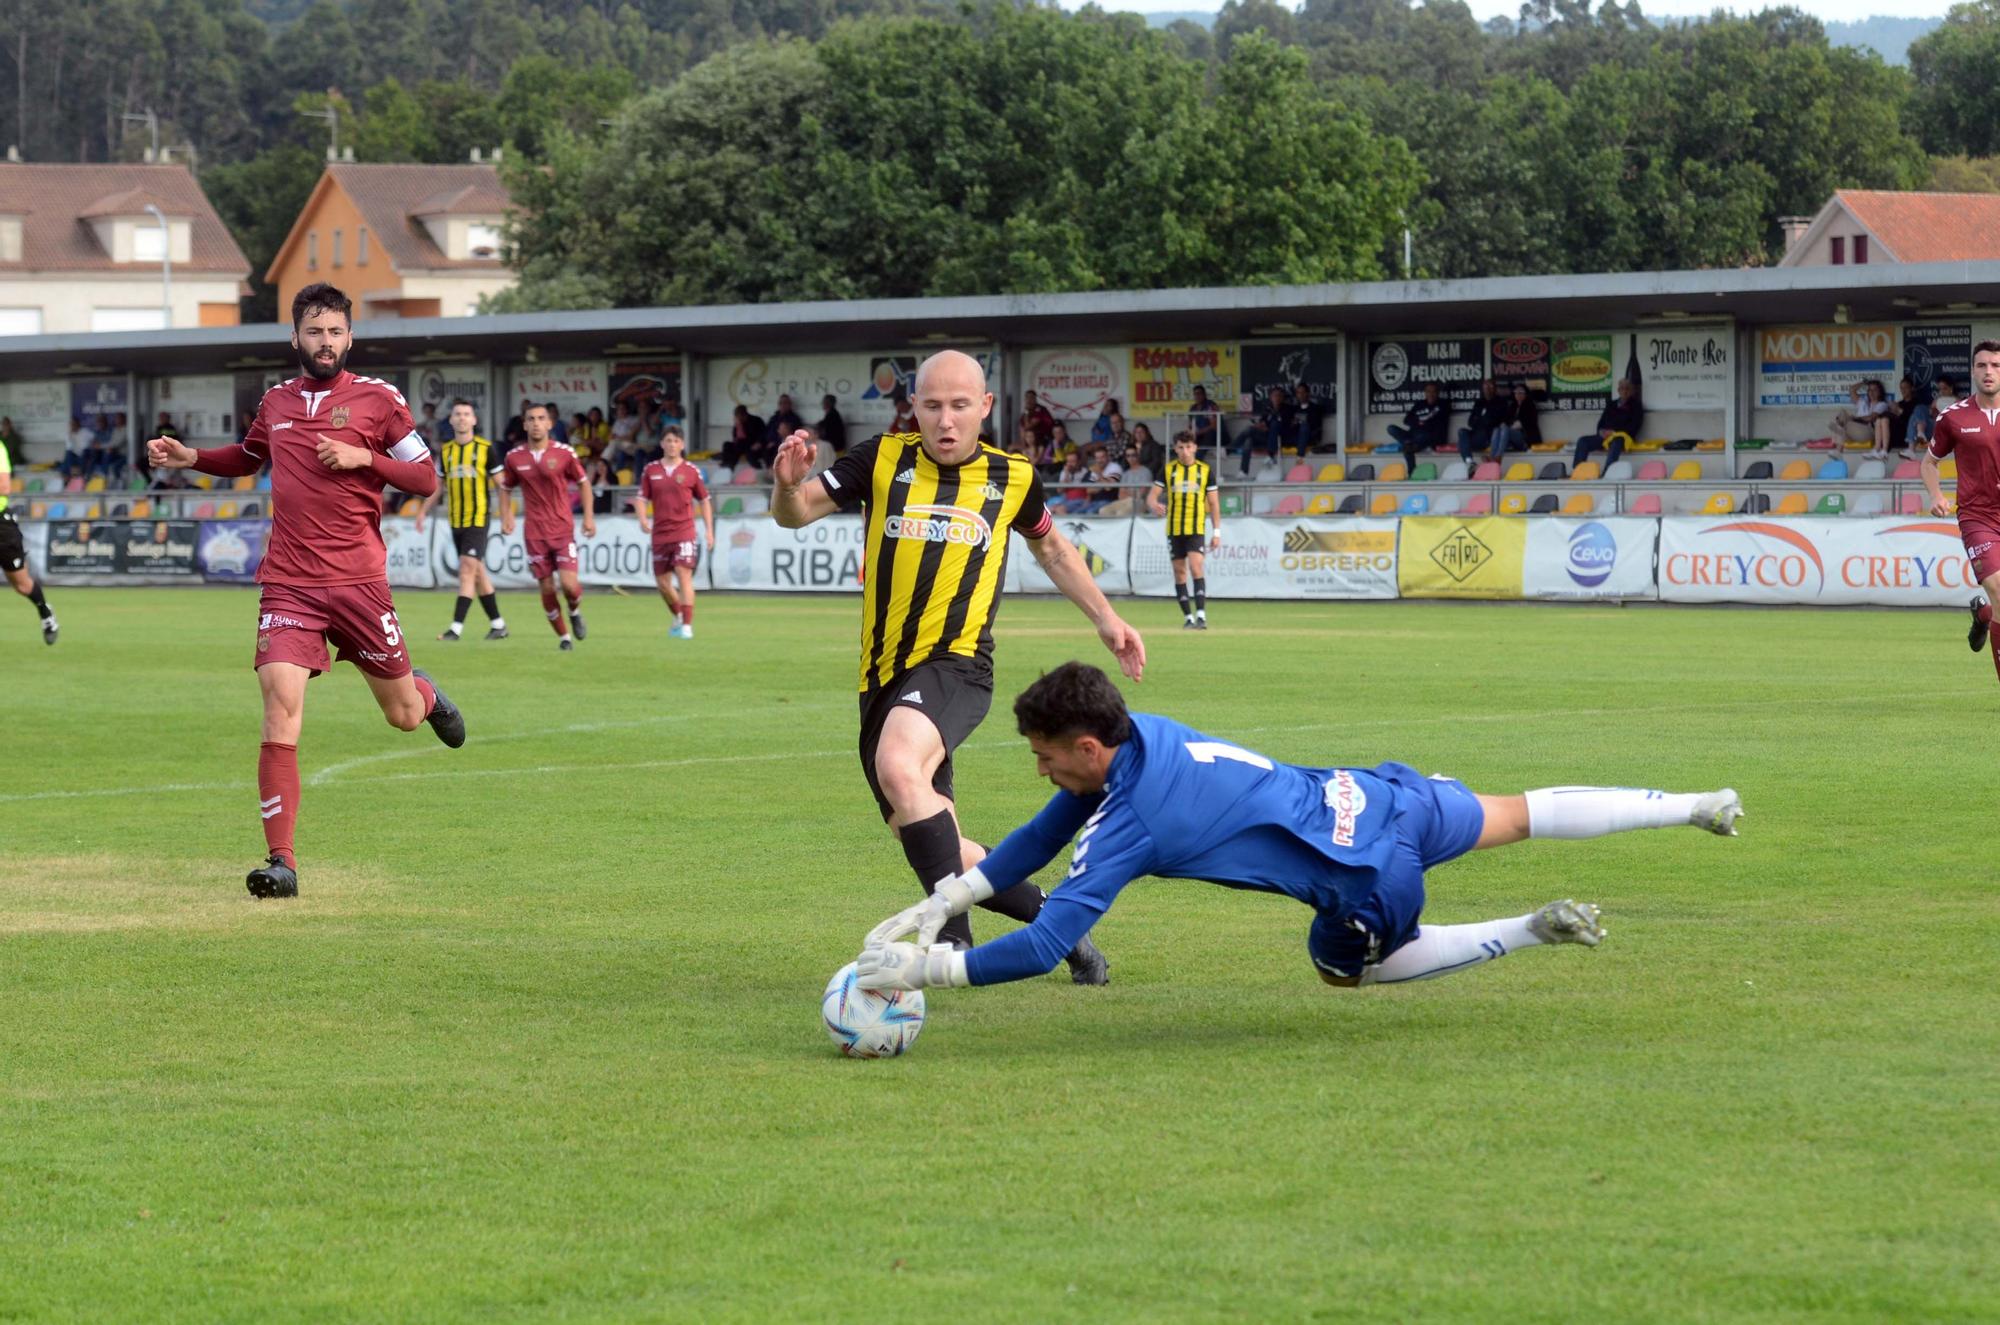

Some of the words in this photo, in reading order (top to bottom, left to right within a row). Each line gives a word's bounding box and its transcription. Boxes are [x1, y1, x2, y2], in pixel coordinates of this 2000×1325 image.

[1427, 343, 1460, 359] M&M
[1499, 342, 1541, 355] AGRO
[1650, 338, 1698, 370] Monte
[1765, 331, 1892, 359] MONTINO
[1410, 364, 1483, 383] PELUQUEROS
[886, 516, 982, 545] CREYCO
[772, 549, 864, 585] RIBA
[1280, 555, 1393, 572] OBRERO
[1442, 535, 1479, 570] FATRO
[1665, 553, 1806, 587] CREYCO
[272, 614, 304, 629] XUNTA
[380, 611, 399, 647] 5
[1184, 742, 1274, 771] 1
